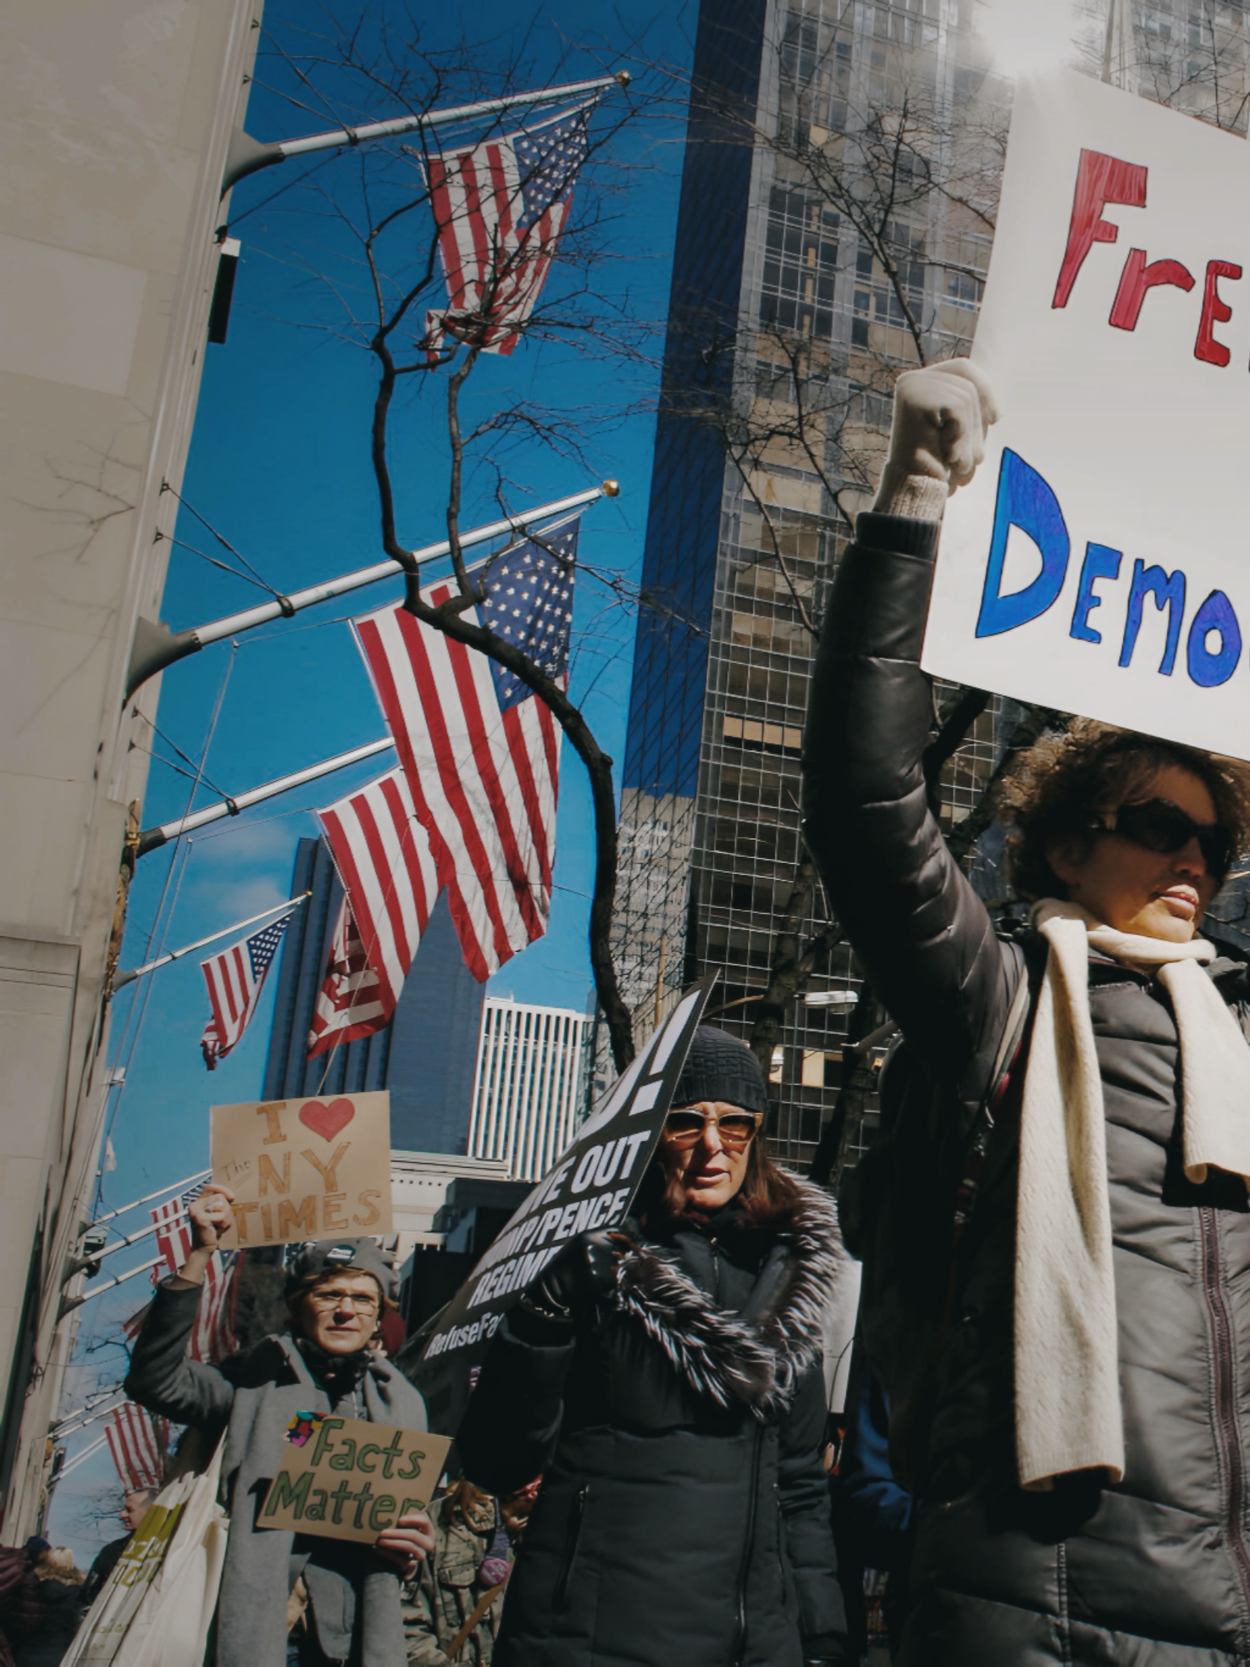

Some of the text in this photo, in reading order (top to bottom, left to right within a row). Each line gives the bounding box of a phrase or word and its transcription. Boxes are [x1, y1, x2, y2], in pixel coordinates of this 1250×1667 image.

[256, 1101, 288, 1145] I
[258, 1141, 351, 1198] NY
[570, 1129, 652, 1194] OUT
[230, 1189, 382, 1244] TIMES
[310, 1418, 426, 1480] Facts
[263, 1470, 426, 1532] Matter
